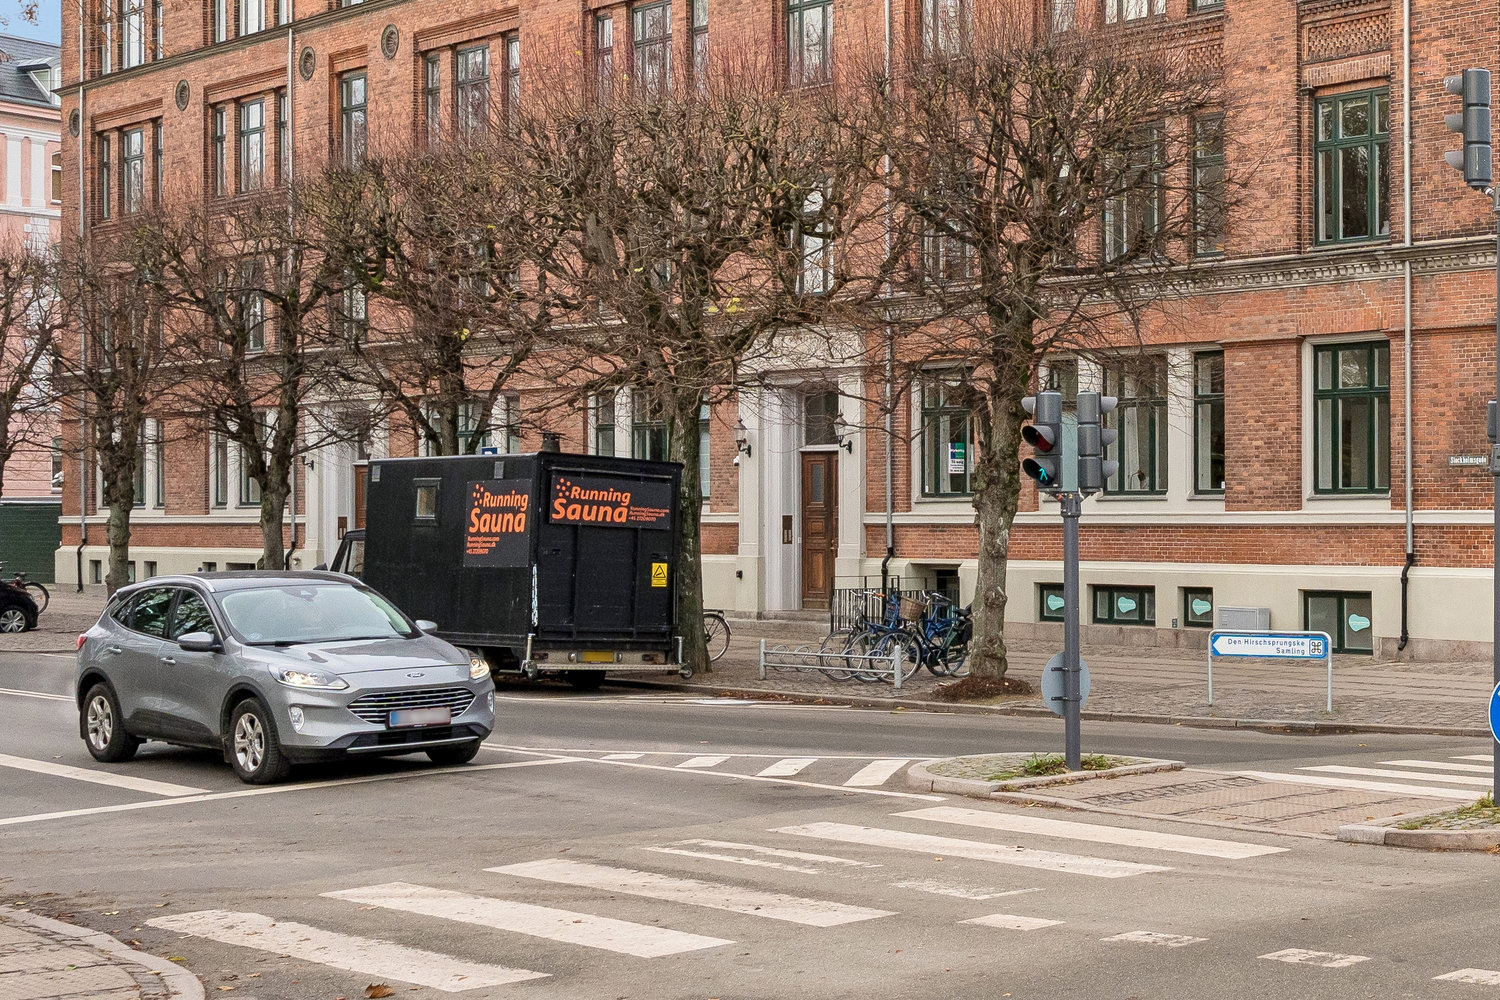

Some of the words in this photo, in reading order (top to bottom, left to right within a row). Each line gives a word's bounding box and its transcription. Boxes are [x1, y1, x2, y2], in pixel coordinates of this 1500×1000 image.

[482, 490, 529, 512] Running
[570, 486, 631, 506] Running
[468, 507, 526, 533] Sauna
[551, 498, 629, 523] Sauna
[1244, 638, 1305, 647] Hirschsprungske
